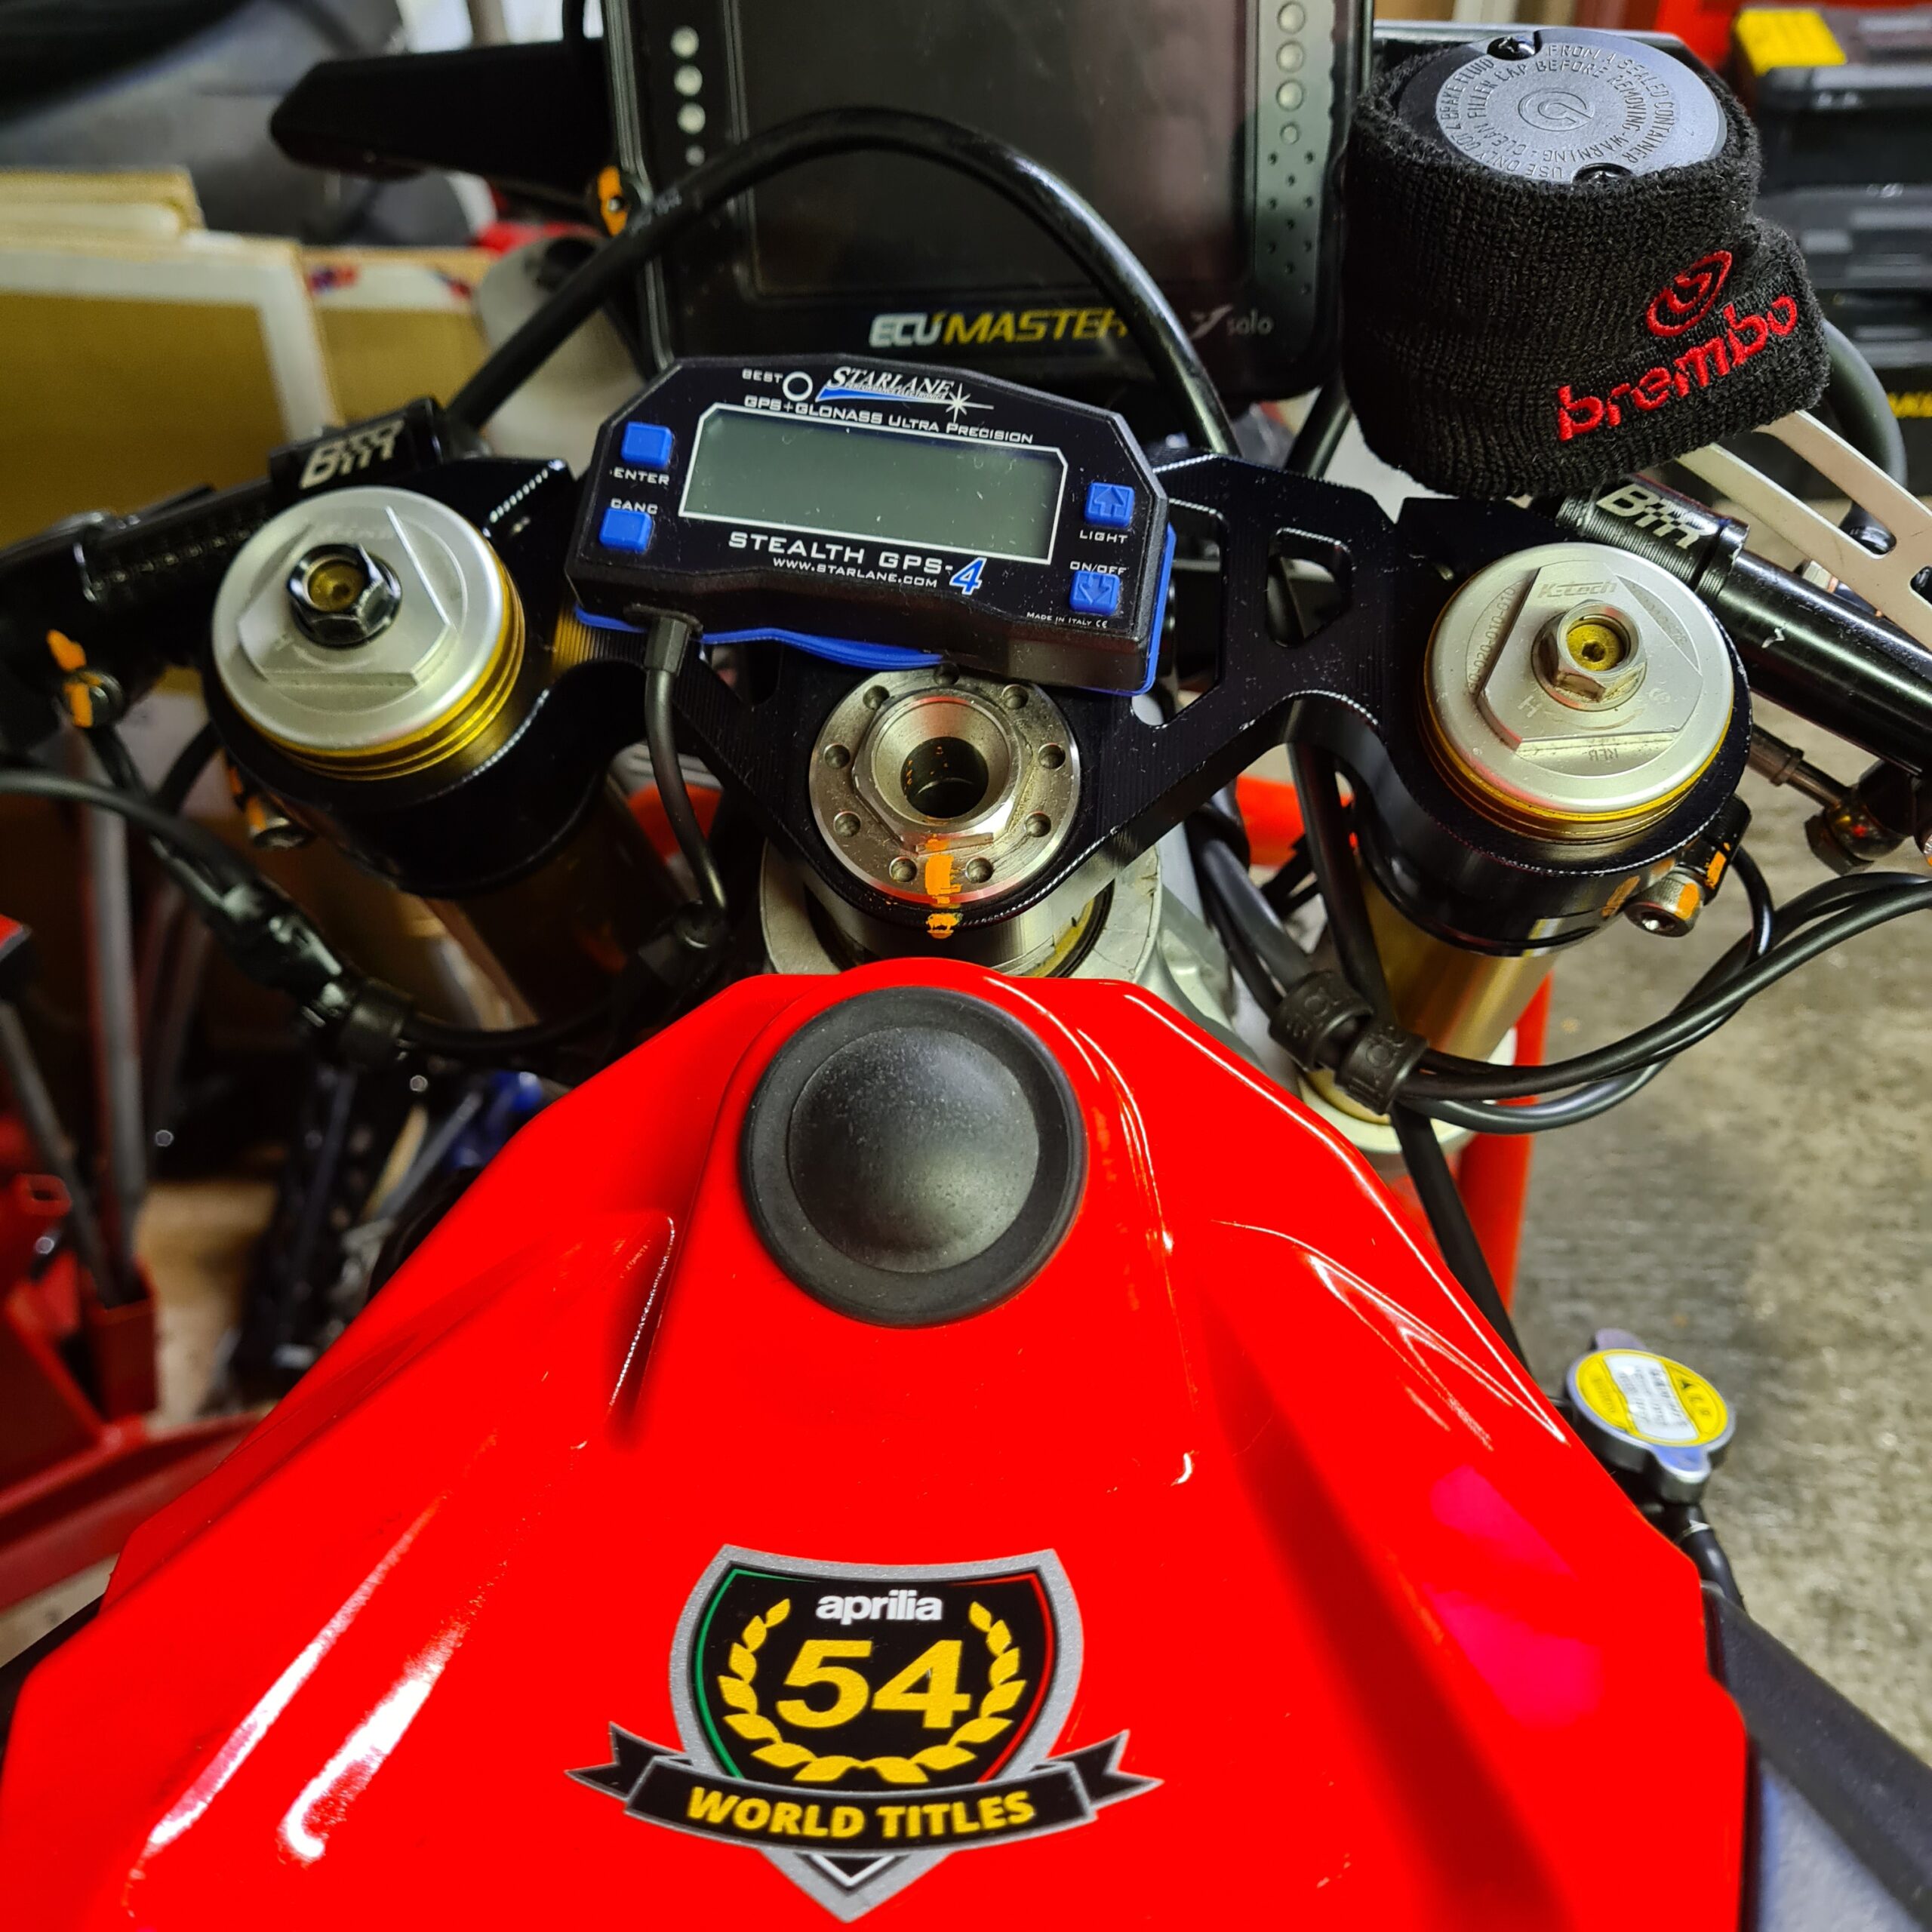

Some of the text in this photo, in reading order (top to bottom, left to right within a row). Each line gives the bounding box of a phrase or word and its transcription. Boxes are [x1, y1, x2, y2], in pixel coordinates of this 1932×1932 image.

[1549, 45, 1601, 60] FROM
[1453, 59, 1494, 84] FLUID
[1494, 63, 1527, 82] CAP
[1535, 60, 1608, 78] BEFORE
[1617, 59, 1669, 97] SEALED
[1440, 85, 1466, 120] BRAKE
[1467, 80, 1498, 118] FILLER
[1622, 102, 1675, 164] CONTAINER
[1543, 134, 1629, 163] WARNING
[1526, 163, 1562, 179] USE
[742, 368, 783, 383] BEST
[826, 366, 955, 395] STARLANE
[1558, 294, 1798, 441] brembo
[743, 394, 1034, 445] GPS+GLONASS ULTRA PRECISION
[613, 466, 669, 485] ENTER
[610, 498, 658, 515] CANC
[728, 531, 865, 564] STEALTH
[1079, 529, 1128, 544] LIGHT
[1069, 561, 1127, 576] ON/OFF
[1026, 611, 1053, 621] MADE
[1068, 617, 1092, 627] ITALY
[814, 1589, 943, 1626] aprilia
[775, 1638, 974, 1730] 54
[687, 1786, 1036, 1839] WORLD TITLES
